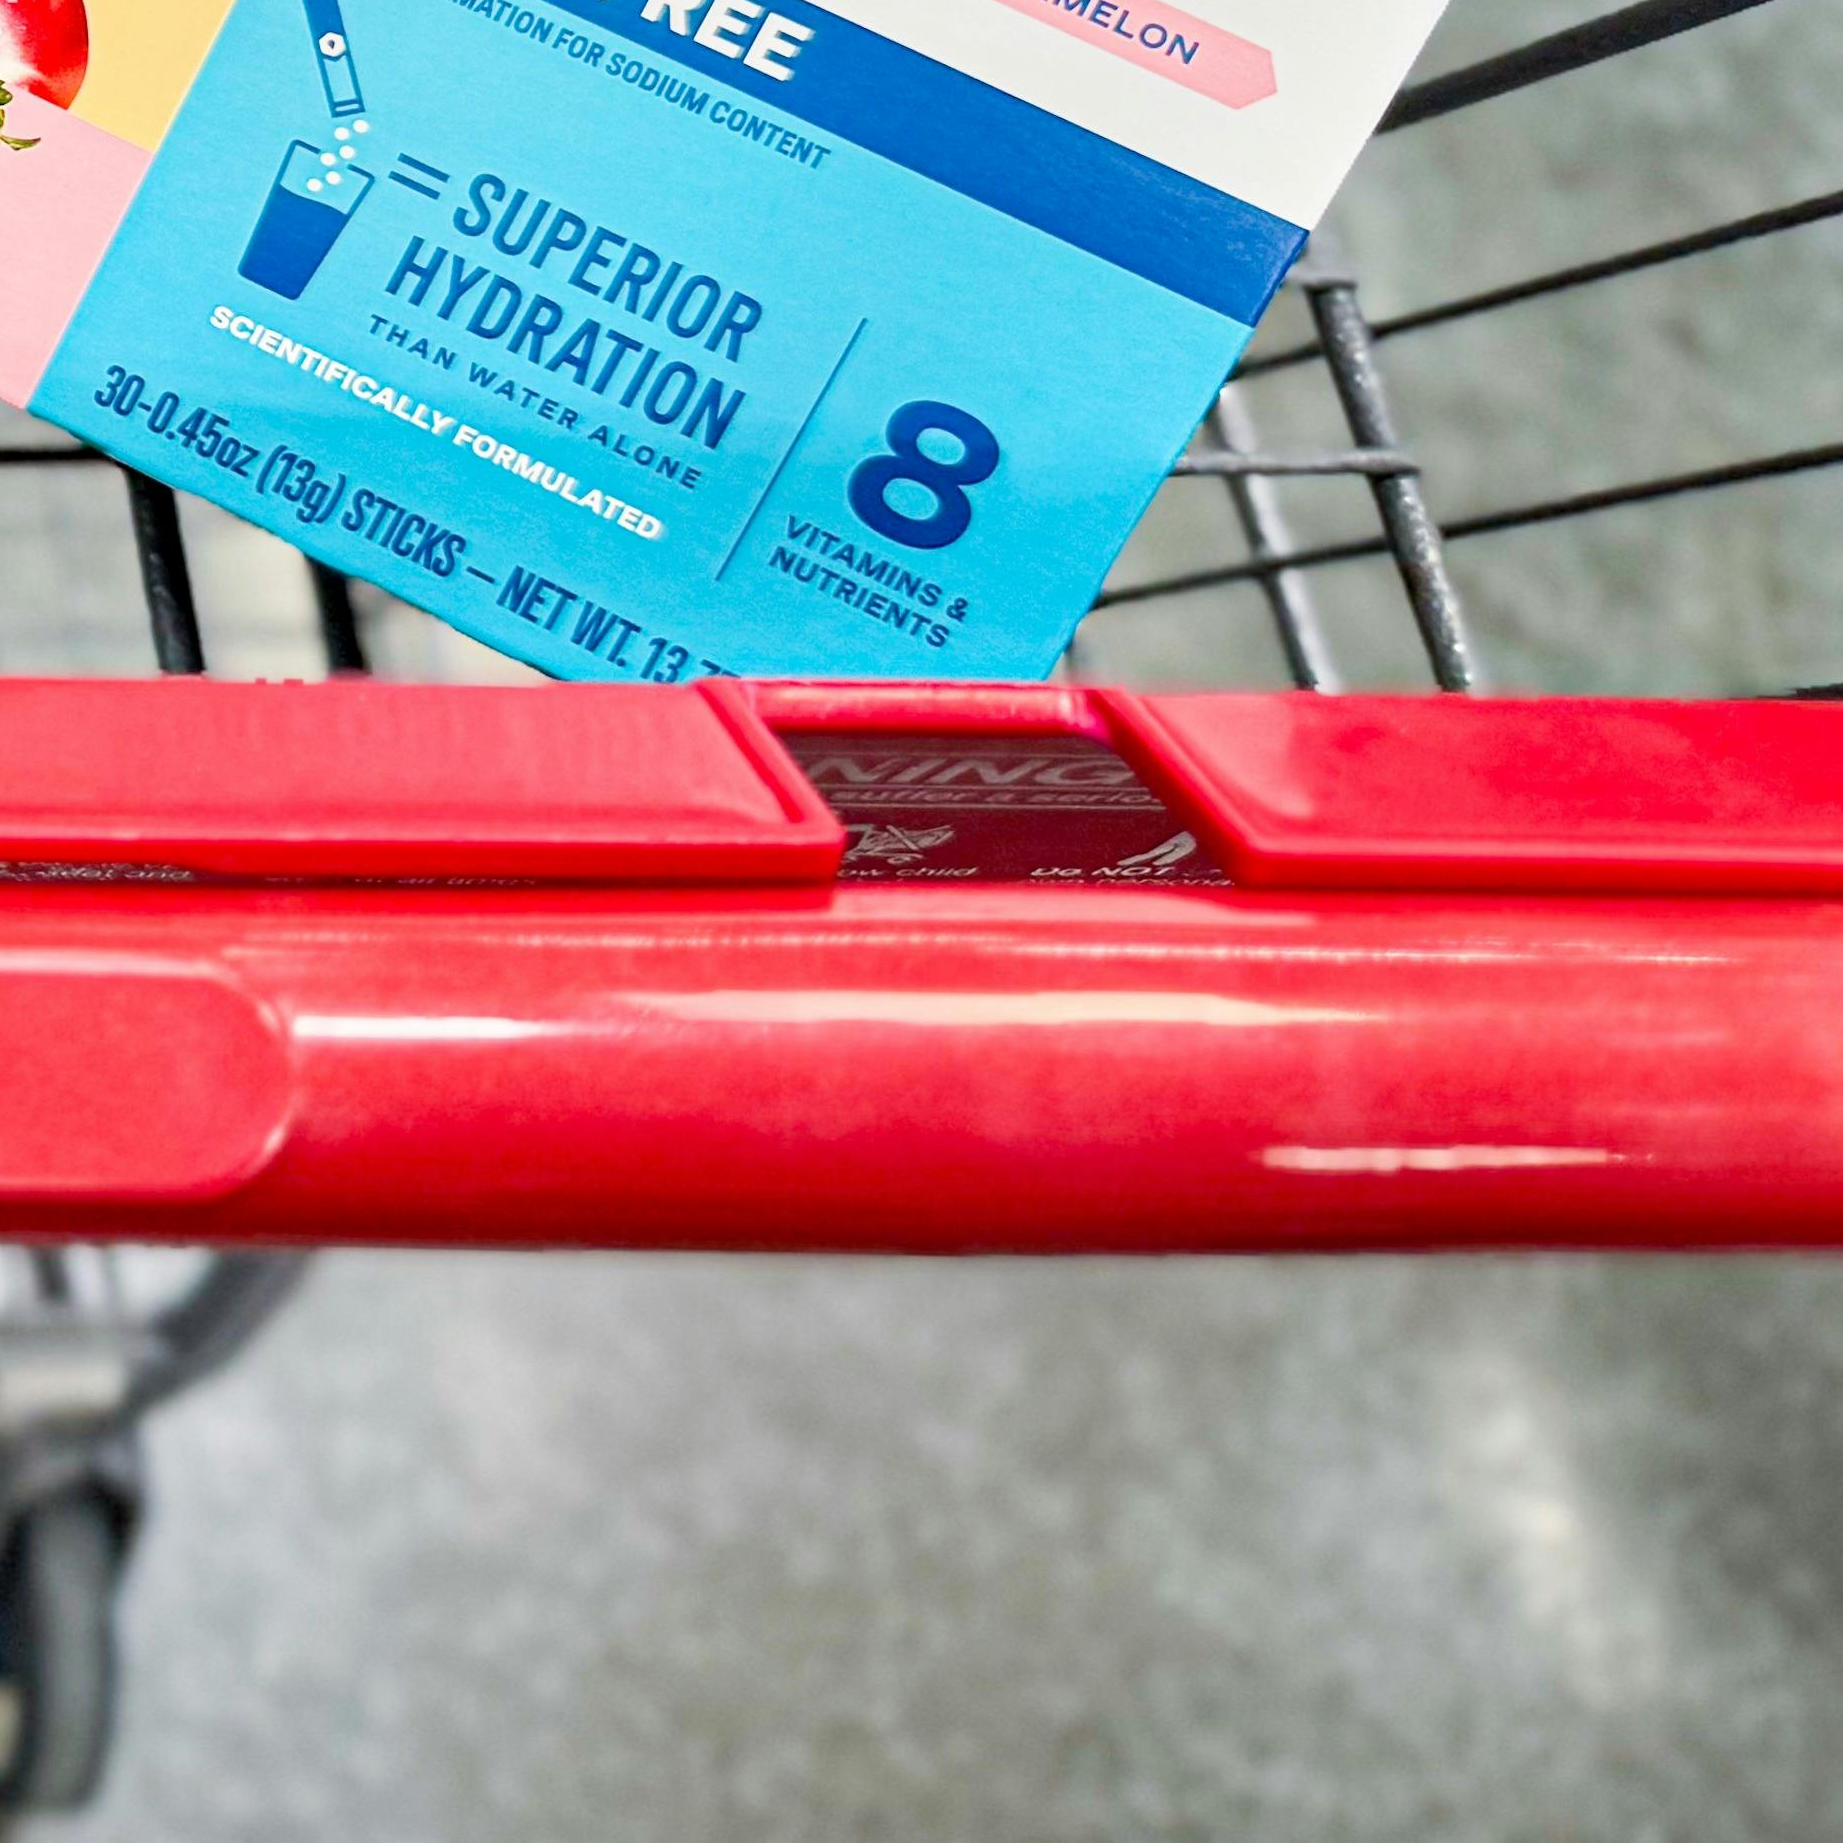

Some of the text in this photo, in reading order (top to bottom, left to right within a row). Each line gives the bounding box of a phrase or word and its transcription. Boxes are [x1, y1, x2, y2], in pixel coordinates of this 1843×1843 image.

[550, 28, 606, 68] FOR
[603, 52, 712, 115] SODIUM
[706, 99, 832, 170] CONTENT
[384, 235, 746, 450] HYDRATION
[452, 172, 762, 364] SUPERIOR
[209, 306, 665, 539] SCIENTIFICALLY FORMULATED
[368, 313, 703, 491] THAN WATER ALONE
[846, 399, 1000, 551] 8
[255, 444, 346, 525] (13g)
[340, 488, 466, 579] STICKS
[495, 566, 577, 630] NET
[571, 600, 642, 668] WT.
[767, 546, 950, 647] NUTRIENTS
[786, 515, 969, 623] VITAMINS &
